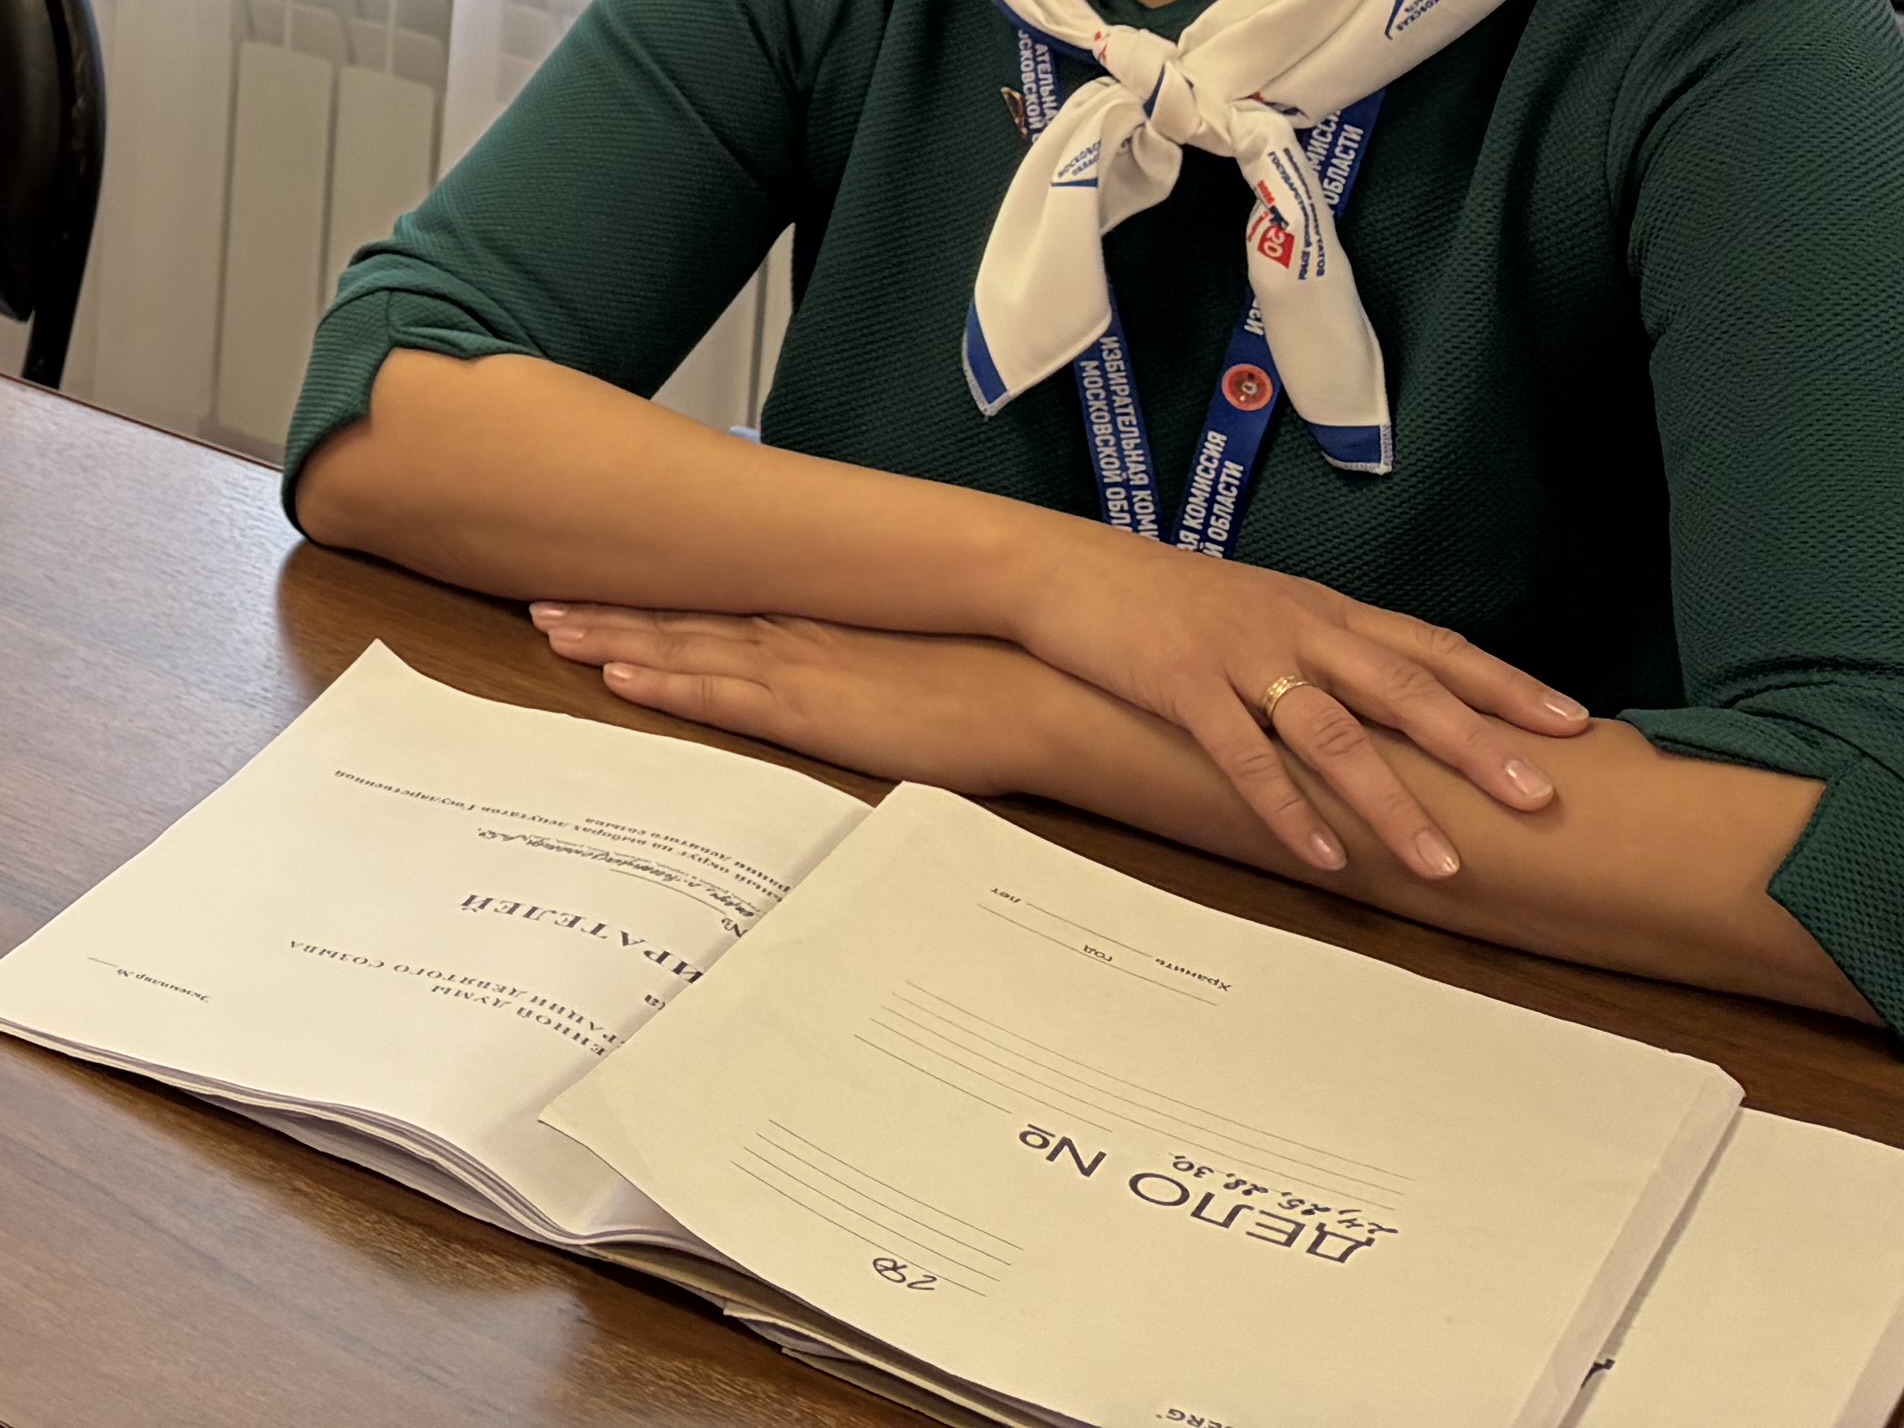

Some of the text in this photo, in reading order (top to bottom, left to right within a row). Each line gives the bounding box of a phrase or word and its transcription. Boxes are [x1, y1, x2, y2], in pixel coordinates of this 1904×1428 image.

[1035, 43, 1059, 126] АТЕЛЬНА
[1263, 228, 1285, 257] 20
[1080, 360, 1128, 483] МОСКОВСКОЙ
[1100, 336, 1149, 486] ИЗБИРАТЕЛЬНАЯ
[1183, 431, 1227, 530] КОМИССИЯ
[1207, 460, 1244, 542] ОБЛАСТИ
[290, 940, 385, 969] СОЗЫВА
[459, 893, 705, 984] ИРАТЕЛЕЙ
[1154, 957, 1232, 992] Хранить
[392, 963, 529, 999] ДЕВЯТОГО
[431, 984, 608, 1058] ЕННОЙ ДУМЫ
[529, 994, 626, 1048] РАЦИИ
[1126, 1171, 1376, 1265] ДЕЛО
[1166, 1407, 1234, 1428] ERG
